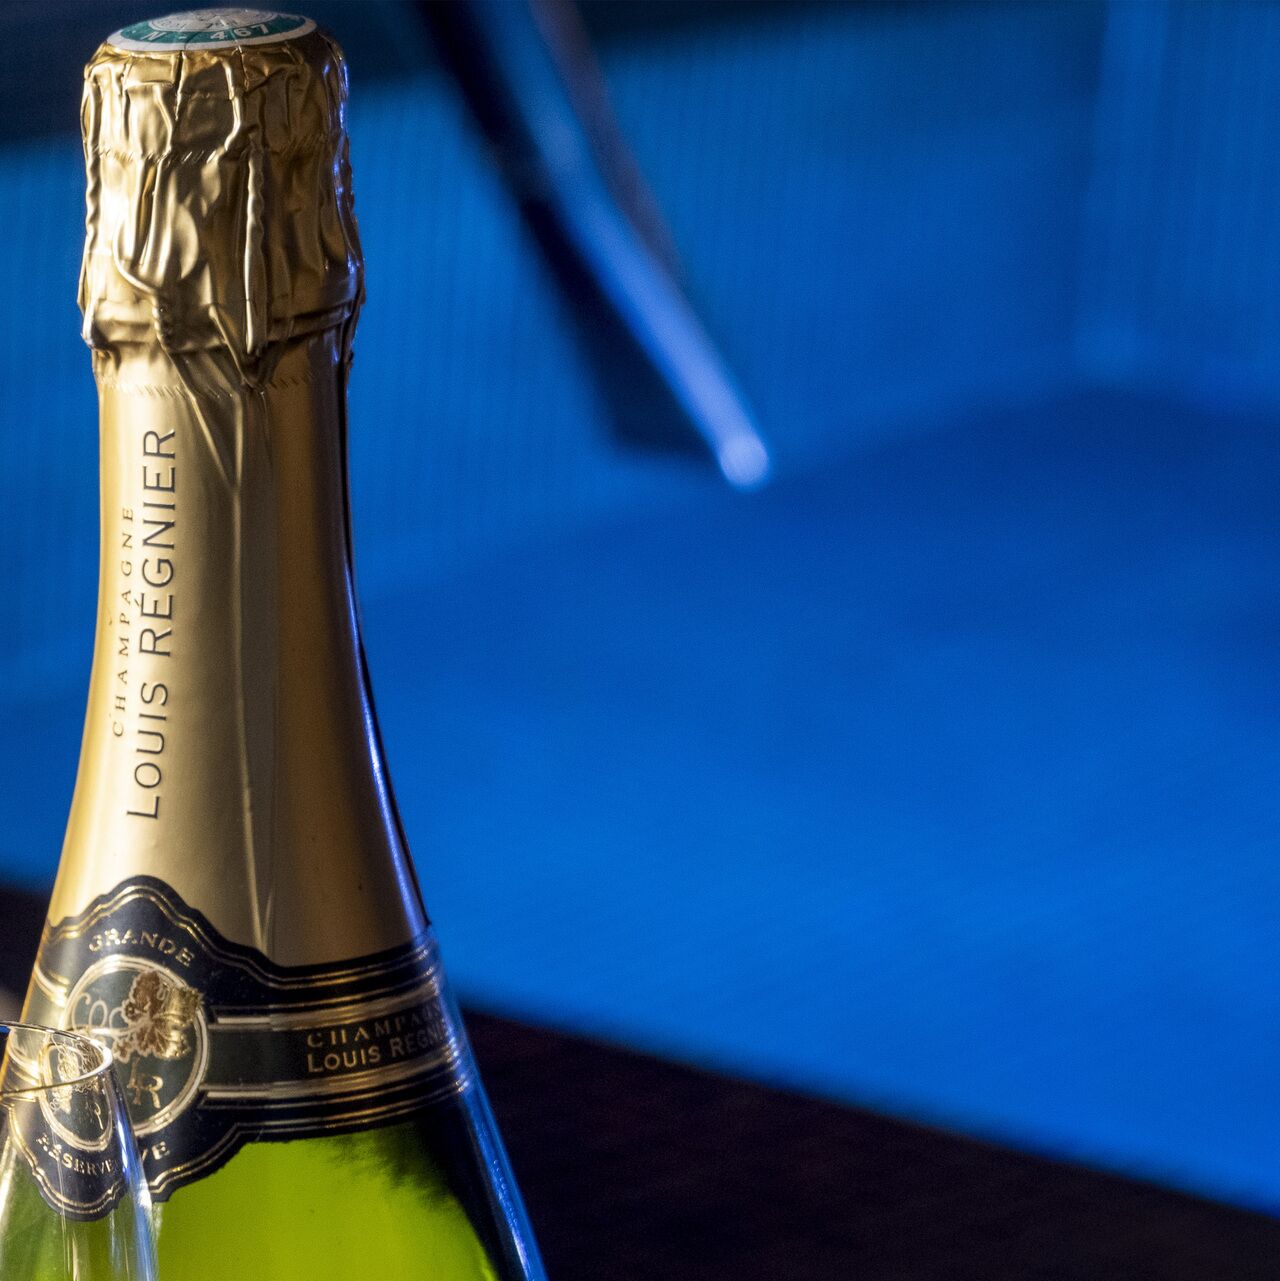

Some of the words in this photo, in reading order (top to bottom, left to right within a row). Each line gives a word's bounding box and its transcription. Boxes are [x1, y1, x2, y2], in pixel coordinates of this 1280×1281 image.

[112, 507, 134, 738] CHAMPAGNE
[134, 429, 176, 657] RÉGNIER
[126, 681, 168, 820] LOUIS
[307, 1045, 381, 1073] LOUIS
